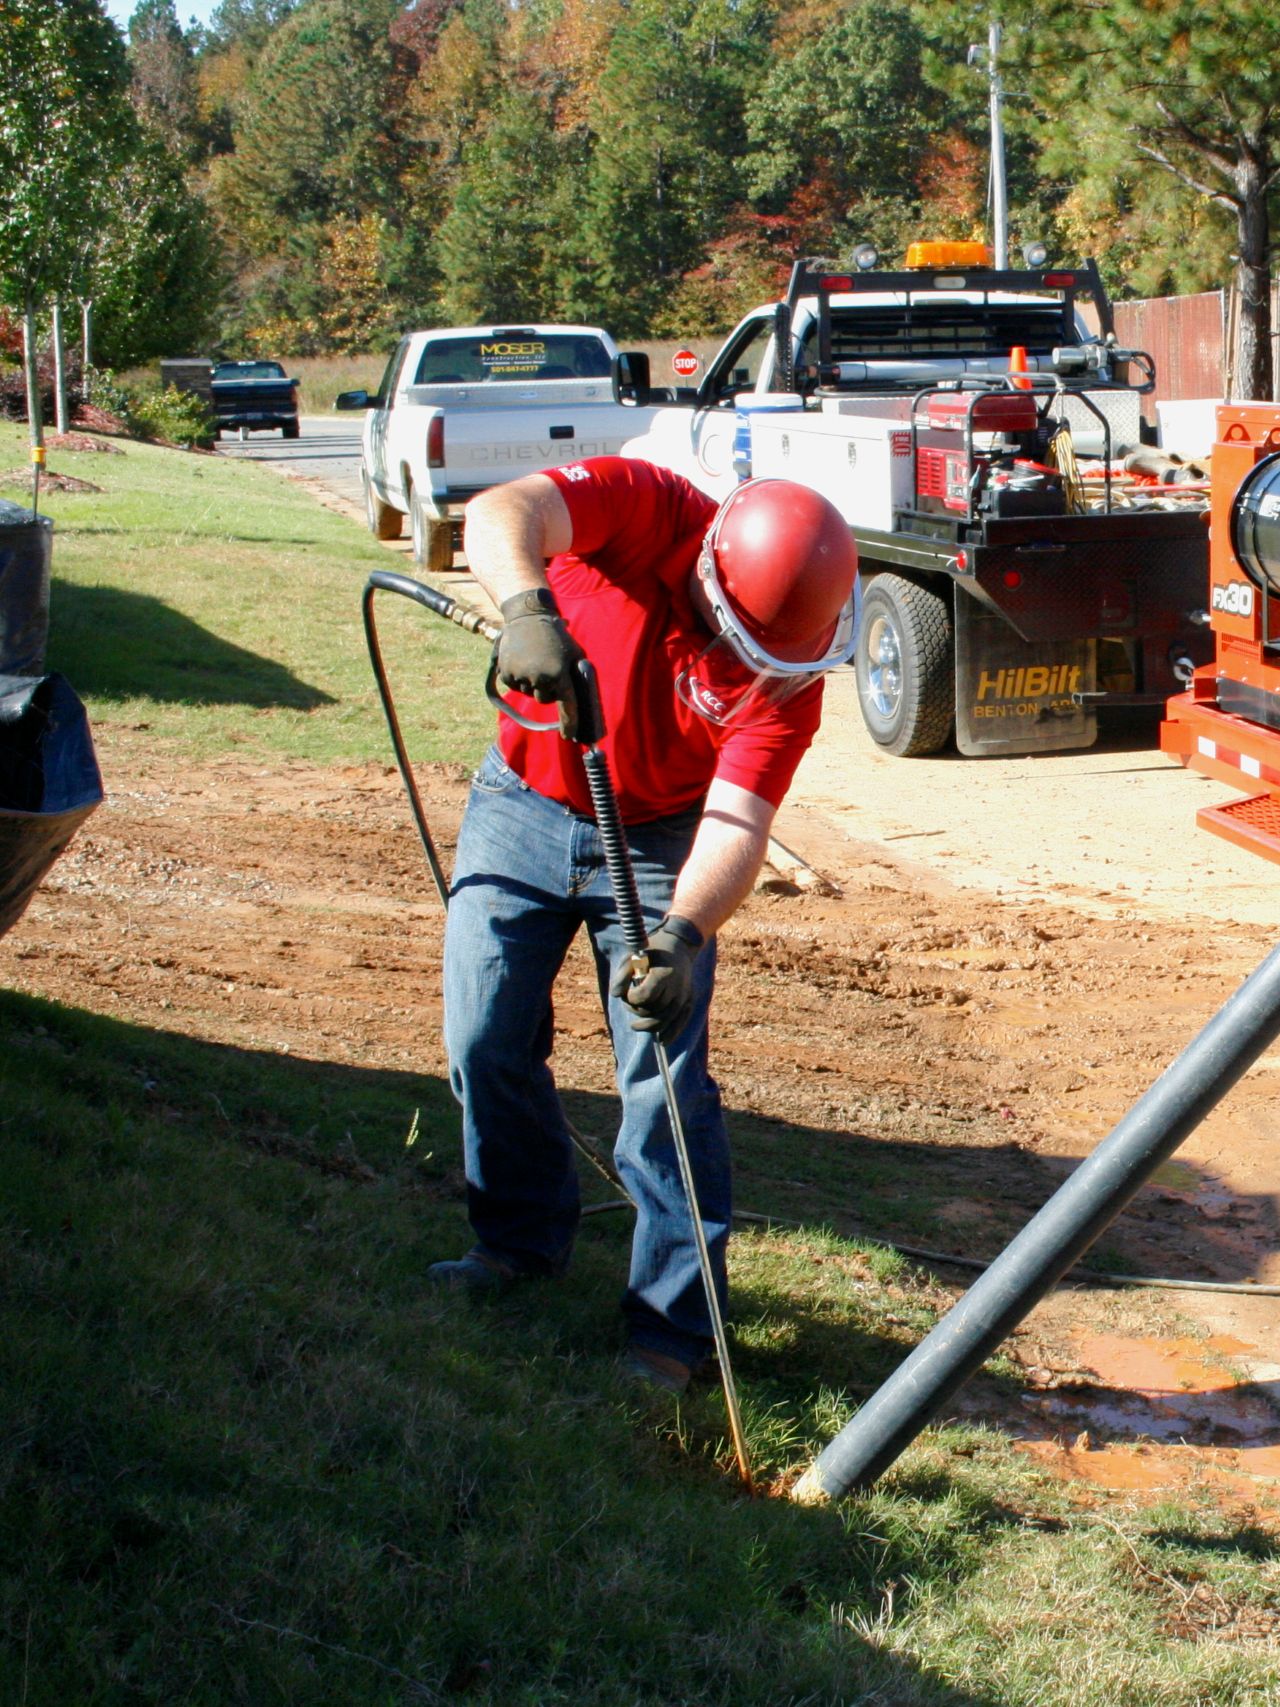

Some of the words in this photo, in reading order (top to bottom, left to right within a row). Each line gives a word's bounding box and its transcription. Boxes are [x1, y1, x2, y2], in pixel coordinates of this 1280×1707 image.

[481, 342, 545, 355] MOSER
[675, 358, 697, 369] STOP
[472, 442, 624, 461] CHEVROL
[1212, 583, 1252, 615] FX30
[977, 664, 1081, 700] HilBilt
[701, 690, 725, 711] RCC
[974, 702, 1038, 718] BENTON
